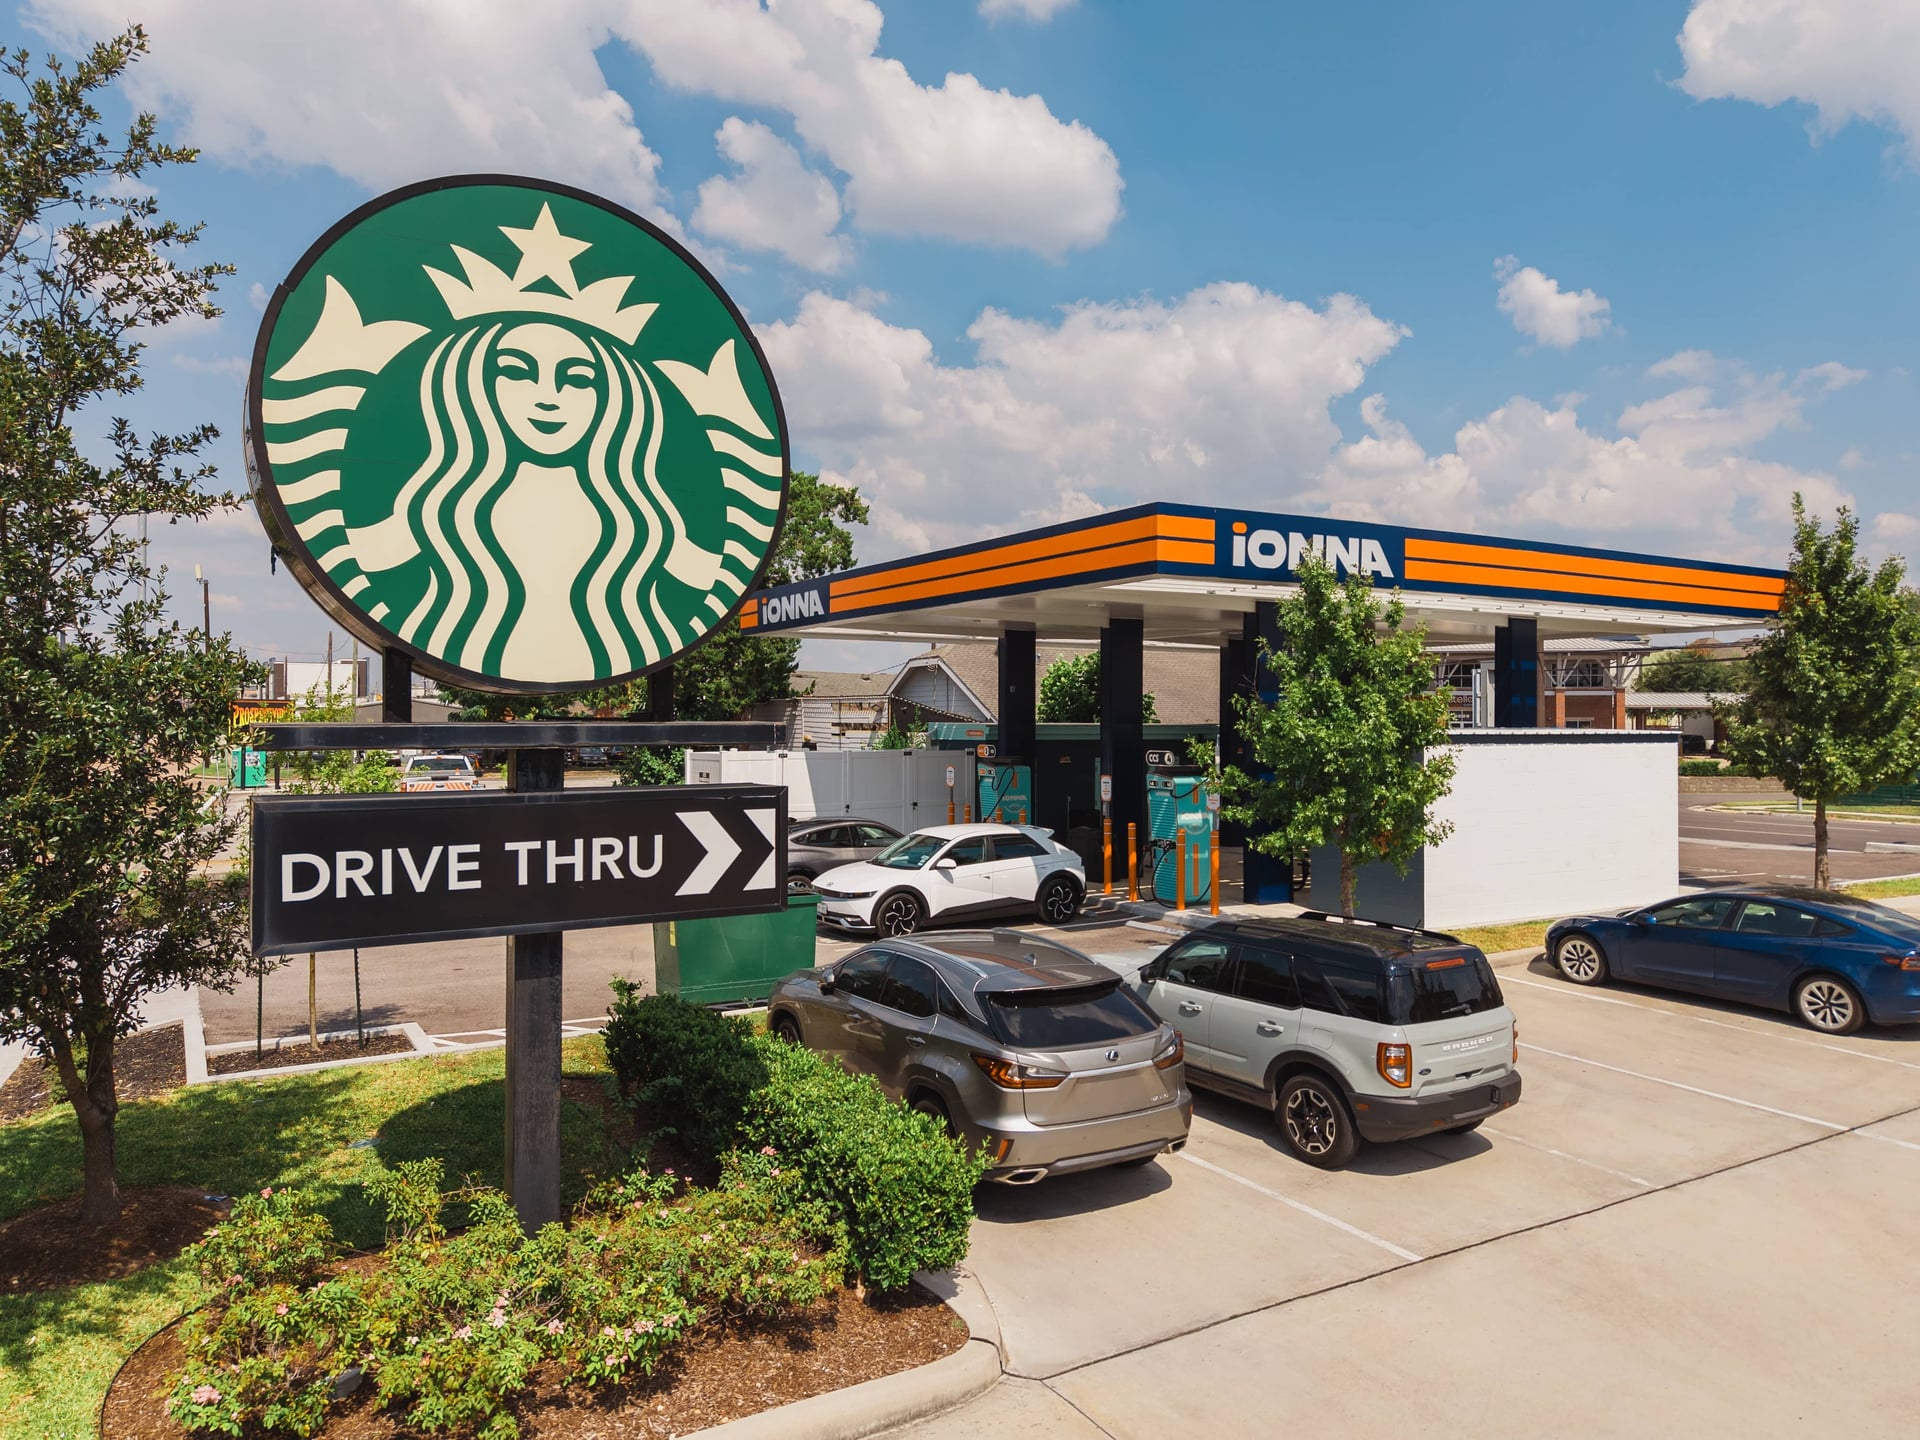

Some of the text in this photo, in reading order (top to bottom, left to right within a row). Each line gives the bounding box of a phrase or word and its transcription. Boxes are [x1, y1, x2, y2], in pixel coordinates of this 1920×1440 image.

[1232, 521, 1395, 579] iONNA
[761, 589, 825, 625] iONNA
[1148, 753, 1159, 763] CCS
[281, 834, 663, 902] DRIVE THRU
[1442, 1036, 1493, 1051] BRONCO
